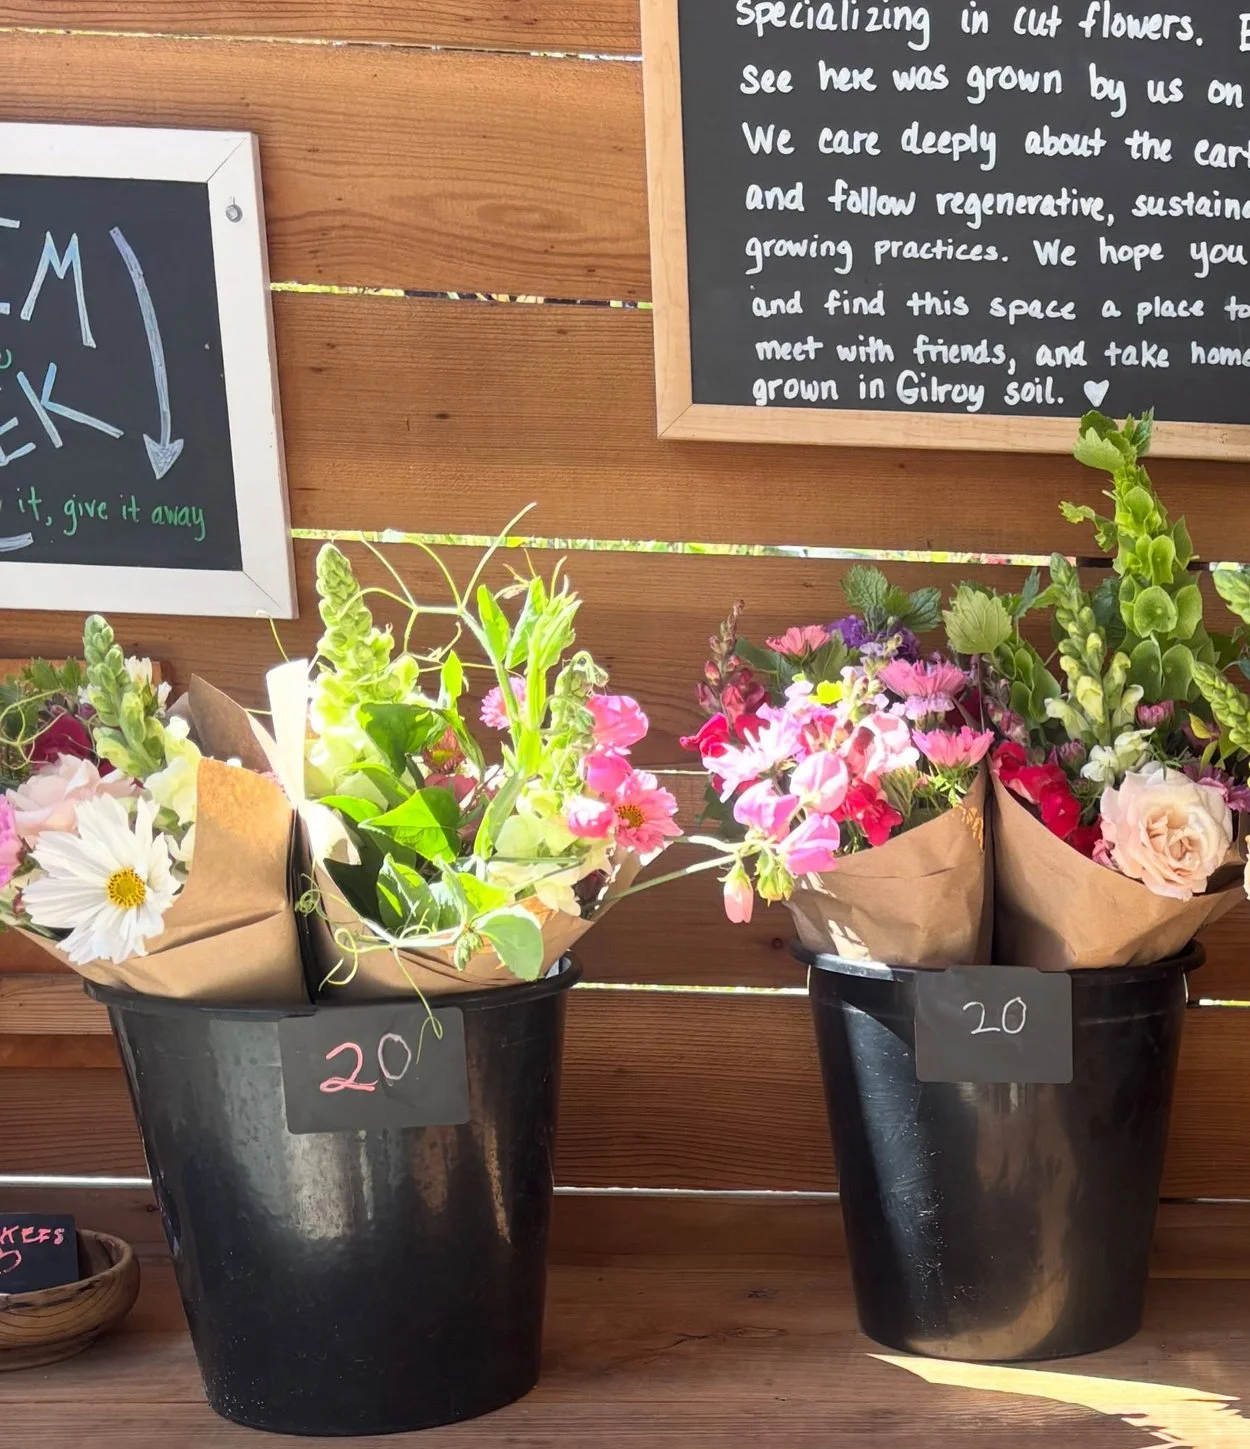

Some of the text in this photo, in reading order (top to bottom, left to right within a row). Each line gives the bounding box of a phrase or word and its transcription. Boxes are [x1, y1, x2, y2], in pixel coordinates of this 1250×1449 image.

[960, 0, 989, 36] in
[1013, 4, 1063, 39] cut
[1077, 0, 1204, 47] flowers.
[817, 59, 878, 92] here
[891, 63, 950, 92] was
[966, 64, 1063, 105] grown
[1088, 62, 1127, 119] by
[1146, 77, 1184, 105] us
[1207, 79, 1244, 109] on
[741, 121, 795, 155] We
[818, 126, 882, 156] care
[900, 120, 997, 172] deeply
[1024, 124, 1108, 158] about
[1124, 129, 1173, 163] the
[745, 181, 805, 212] and
[827, 178, 917, 218] follow
[935, 186, 1115, 230] regenerative,
[745, 233, 853, 276] growing
[873, 238, 1009, 266] practices.
[1032, 238, 1077, 267] We
[1099, 236, 1165, 272] hope
[1189, 241, 1248, 279] you
[749, 289, 804, 319] and
[823, 288, 886, 317] find
[905, 289, 970, 317] this
[988, 296, 1077, 326] space
[1101, 299, 1122, 318] a
[1136, 295, 1205, 325] place
[754, 335, 824, 362] meet
[835, 334, 895, 364] with
[912, 333, 1017, 375] friends,
[1035, 340, 1088, 369] and
[1103, 339, 1170, 369] take
[752, 369, 1064, 413] grown in Gilroy soil.
[17, 486, 206, 542] it, give it away
[962, 996, 1028, 1035] 20
[319, 1032, 412, 1093] 20
